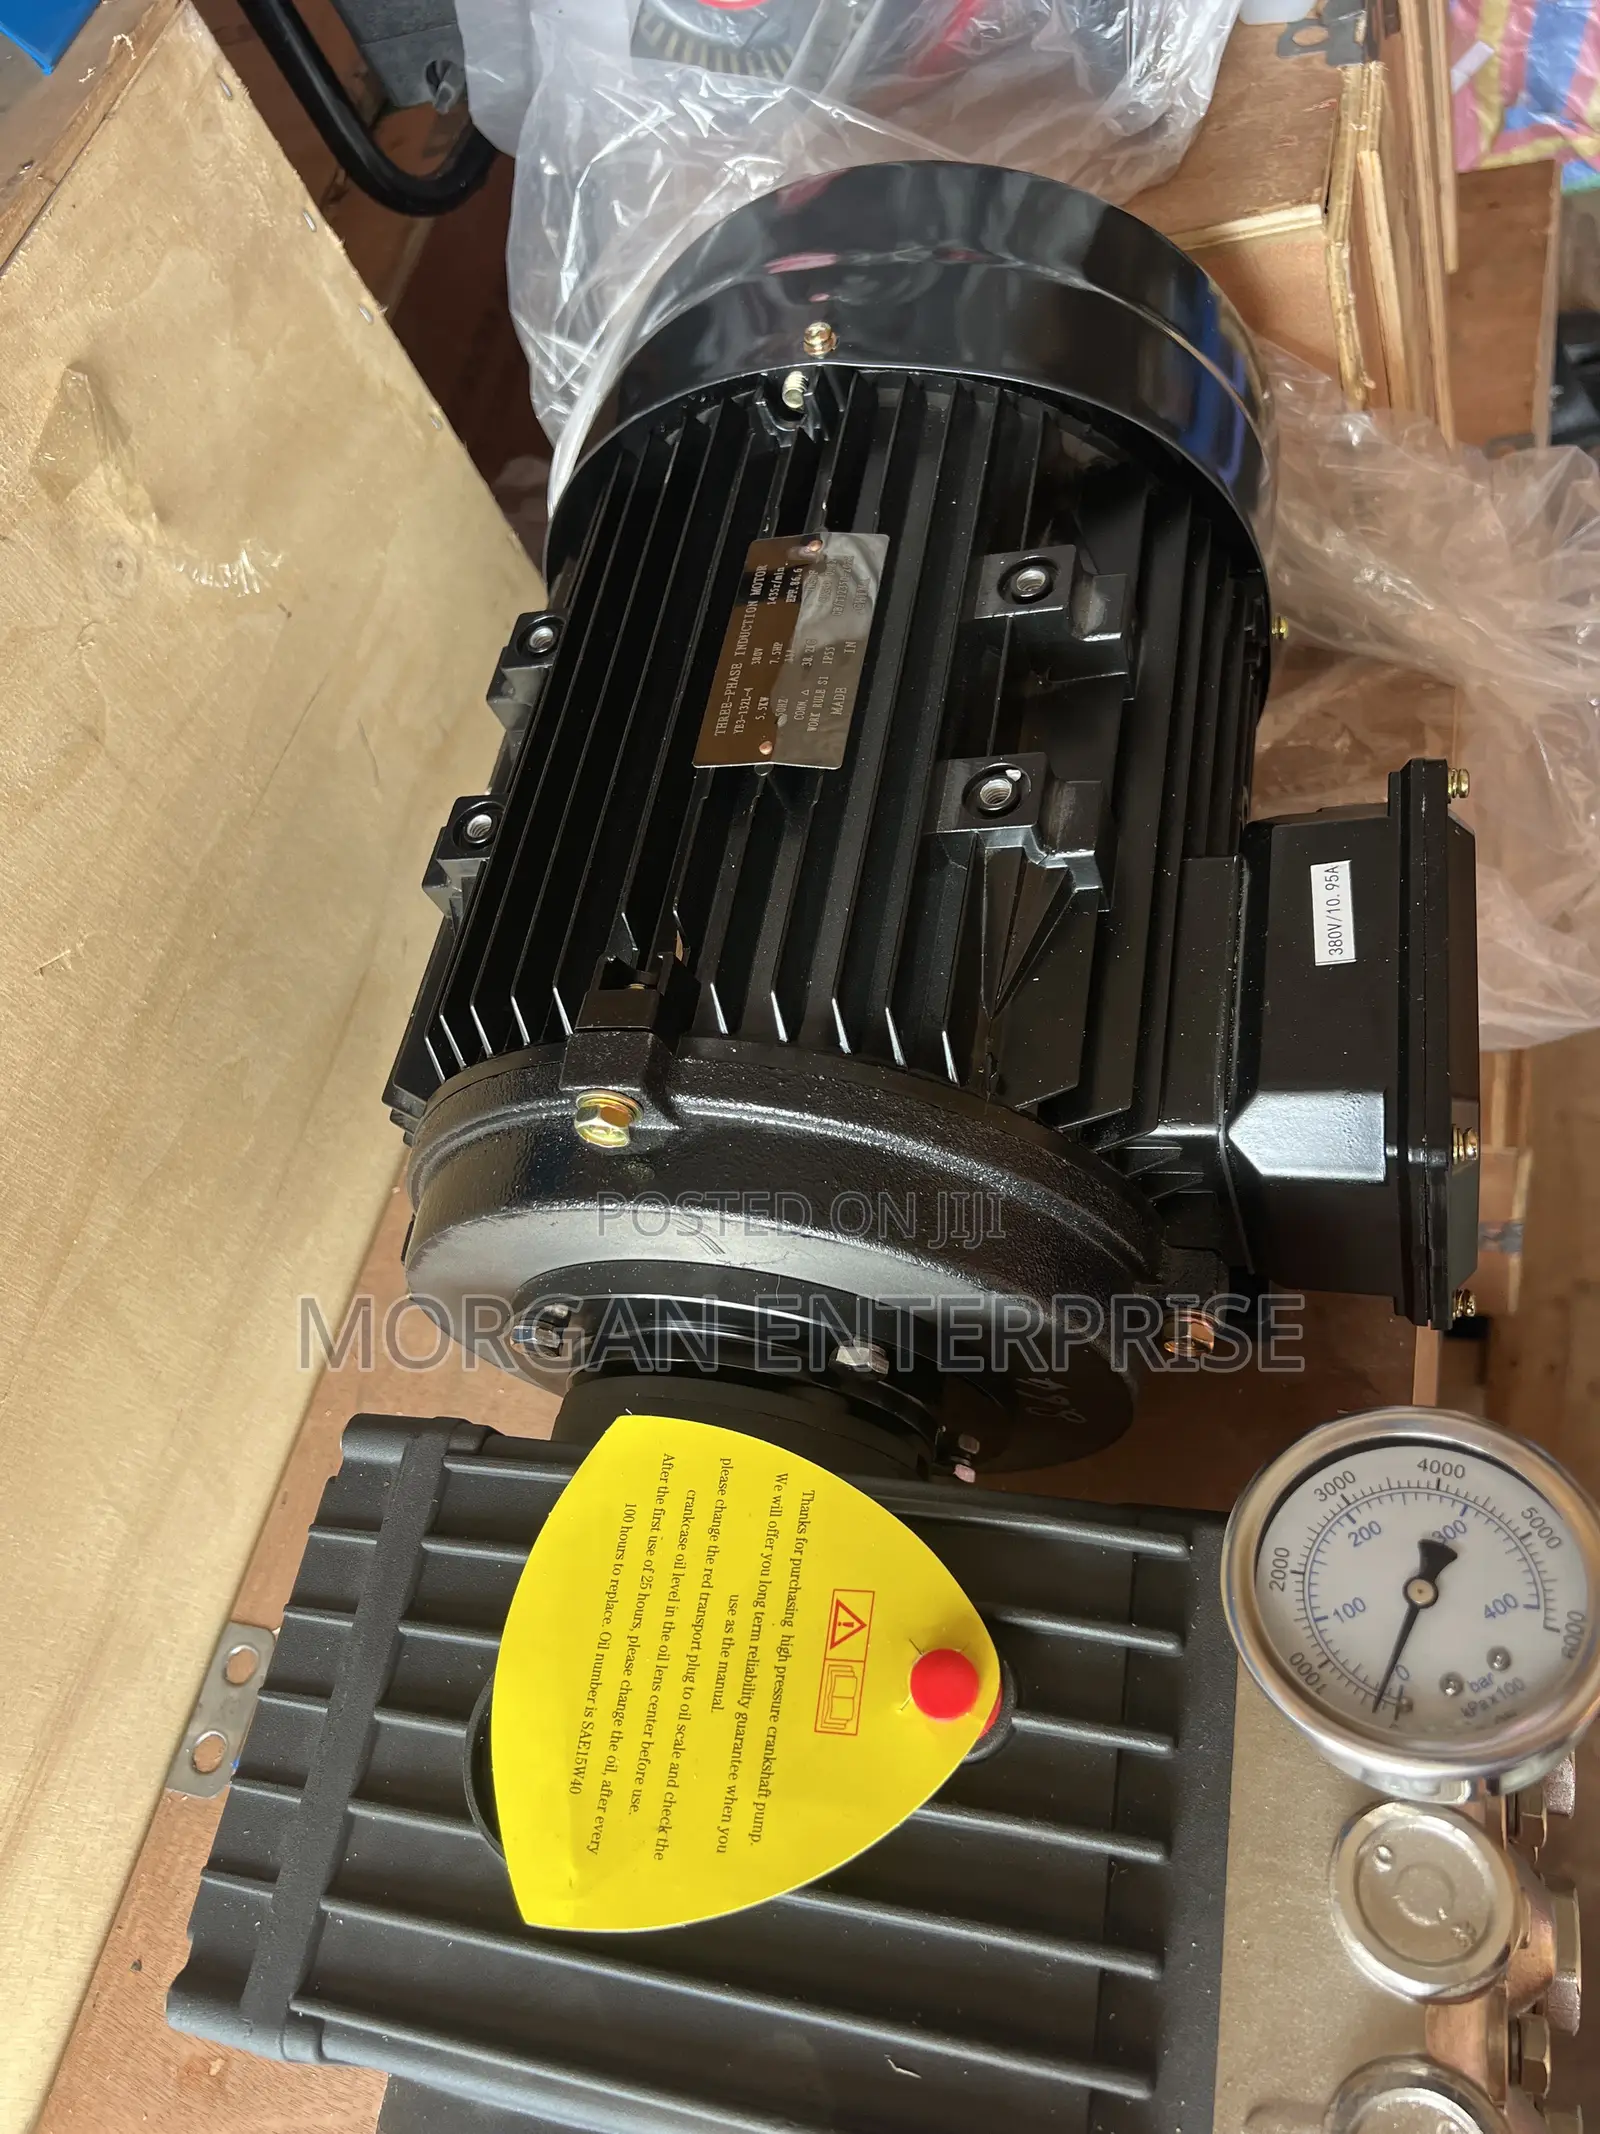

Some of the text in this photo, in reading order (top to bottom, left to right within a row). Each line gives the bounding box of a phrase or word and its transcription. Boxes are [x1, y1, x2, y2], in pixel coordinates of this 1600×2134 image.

[713, 564, 768, 735] THREE-PHASE INDUCTION MOTOR
[750, 647, 764, 664] 380V
[769, 641, 783, 664] 7.5HP
[821, 646, 835, 663] IP55
[812, 689, 826, 707] RULE
[830, 687, 846, 714] MADE
[843, 641, 856, 653] IN
[755, 696, 770, 719] 5.5KW
[807, 712, 821, 731] WORK
[1324, 864, 1344, 956] 380V/10.95A
[1313, 1470, 1356, 1502] 3000
[1417, 1458, 1465, 1478] 4000
[1348, 1520, 1382, 1547] 200
[1431, 1519, 1467, 1546] 300
[1521, 1507, 1563, 1550] 5000
[1269, 1547, 1290, 1592] 2000
[1332, 1597, 1367, 1623] 100
[1483, 1593, 1519, 1620] 400
[569, 1503, 637, 1795] 100 hours to replace. Oil number is SAE15W40
[586, 1453, 676, 1856] After the first use of 25 hours, please change the oil, after every
[629, 1489, 696, 1815] crankcase oil level in the oil lens center before use.
[711, 1594, 740, 1713] use as the manual.
[1562, 1610, 1585, 1659] 6000
[653, 1458, 735, 1861] please change the red transport plug to oil scale and check the
[716, 1472, 789, 1854] We will offer you long term reliability guarantee when you
[748, 1489, 816, 1846] Thanks for purchasing high pressure crankshaft pump.
[1289, 1652, 1326, 1696] 1000
[1468, 1673, 1494, 1693] bar
